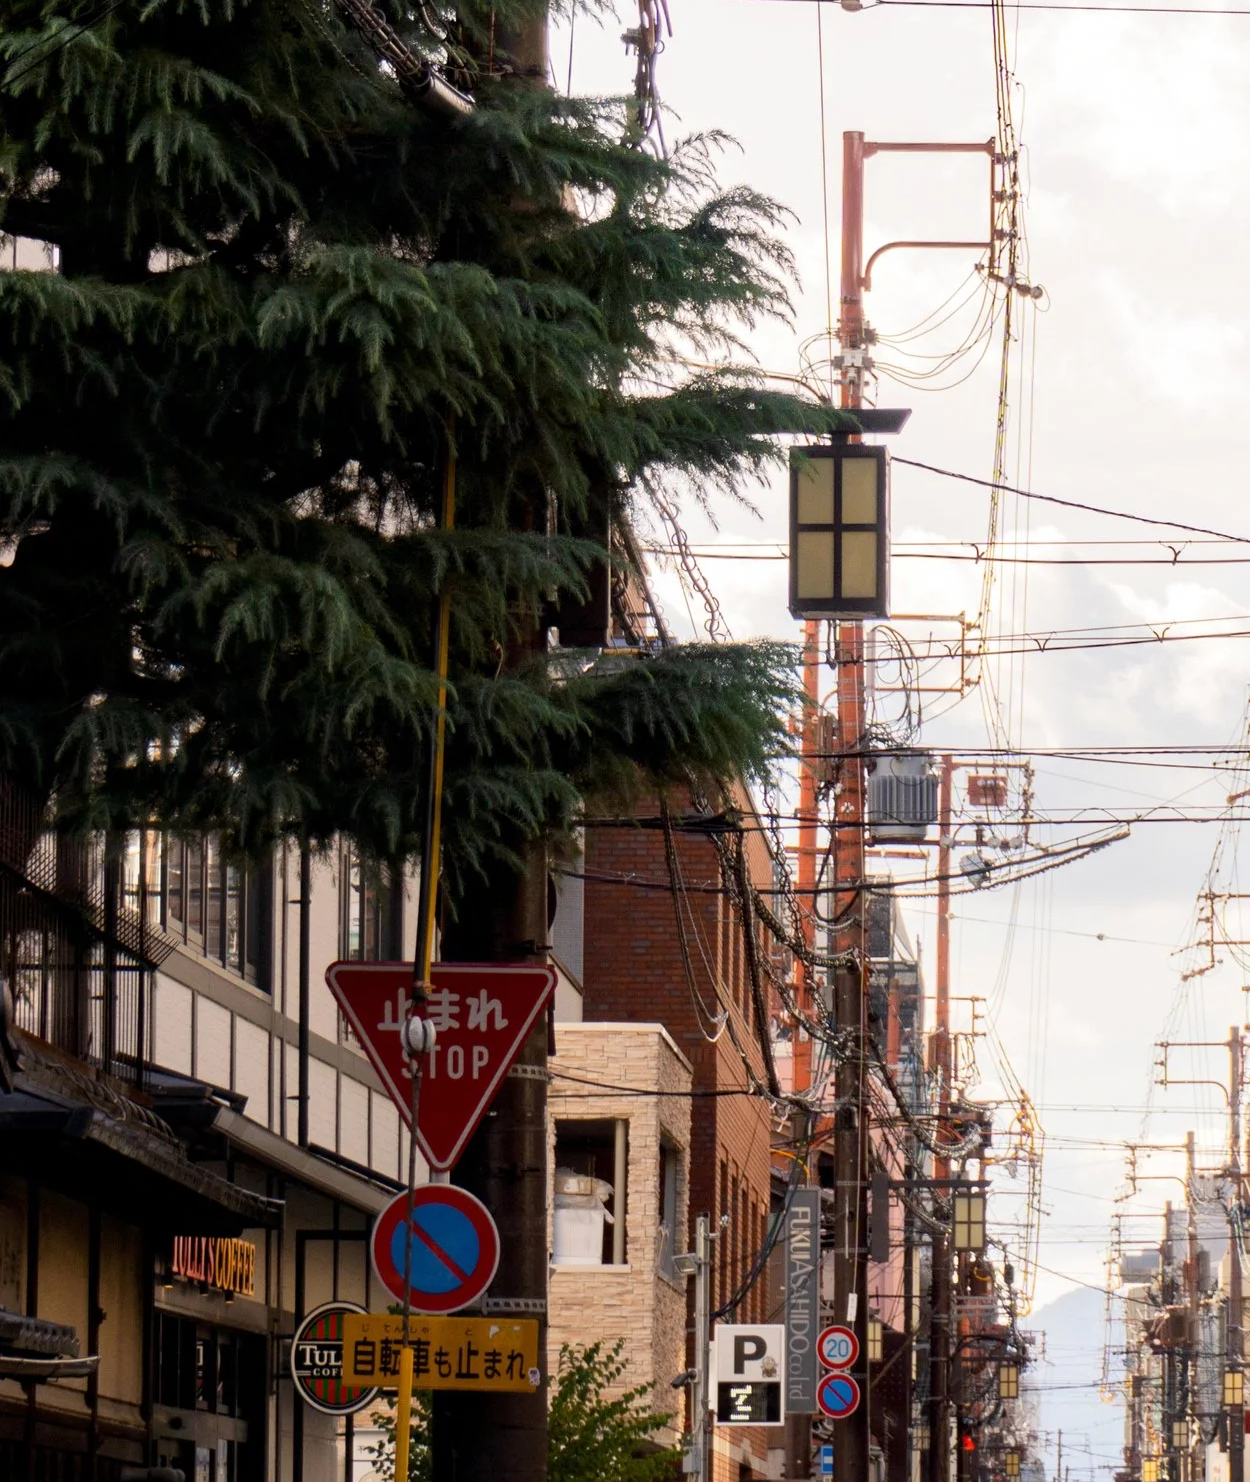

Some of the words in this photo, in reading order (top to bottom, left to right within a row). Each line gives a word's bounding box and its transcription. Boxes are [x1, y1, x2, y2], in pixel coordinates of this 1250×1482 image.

[377, 987, 509, 1032] 止まれ
[401, 1044, 490, 1080] STOP
[215, 1237, 256, 1296] COFFEE
[298, 1344, 344, 1367] TUL
[353, 1337, 526, 1380] 自転車も止まれ
[733, 1334, 767, 1375] P
[826, 1338, 850, 1358] 20
